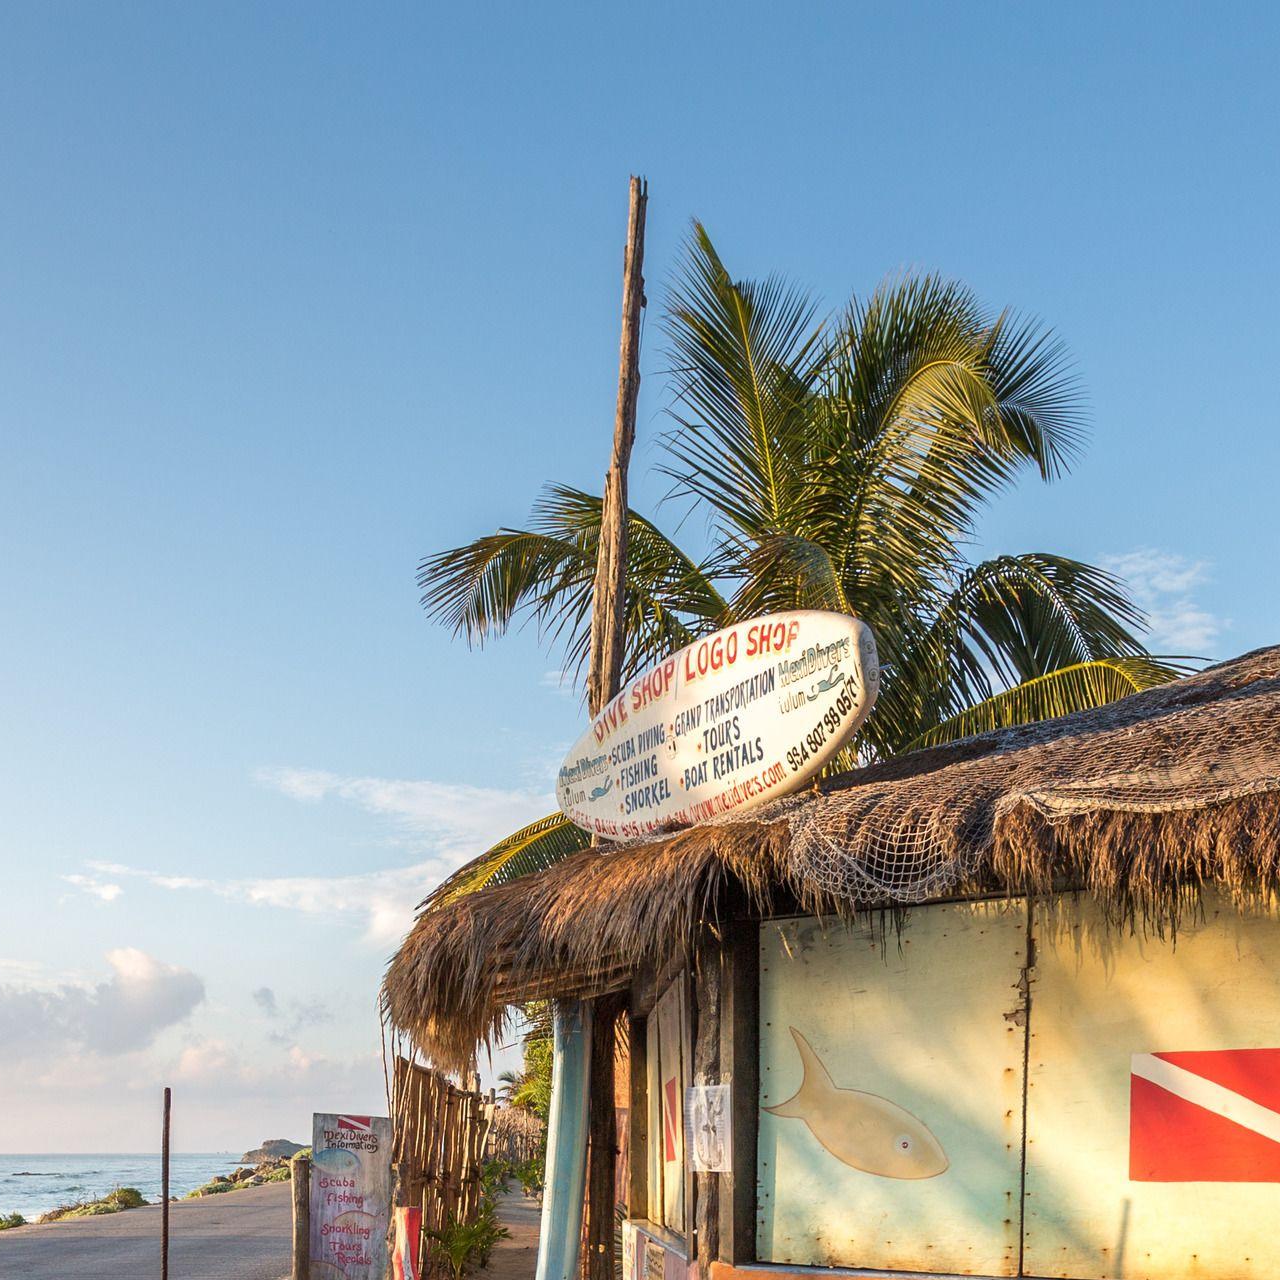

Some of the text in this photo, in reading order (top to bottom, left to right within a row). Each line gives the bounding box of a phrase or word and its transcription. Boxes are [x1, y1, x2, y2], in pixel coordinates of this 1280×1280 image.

[777, 637, 851, 688] MexiDivers
[593, 621, 799, 744] DIVE SHOP LOGO SHOP
[675, 667, 775, 737] GRAND TRANSPORTATION
[611, 723, 666, 767] SCUBA DIVING
[703, 716, 741, 754] TOURS
[806, 720, 827, 754] 807
[620, 755, 658, 791] FISHING
[684, 737, 764, 792] BOAT RENTALS
[625, 777, 671, 815] SNORKEL
[594, 817, 619, 837] DAILY
[324, 1138, 378, 1154] Information
[319, 1176, 355, 1188] Scuba
[328, 1241, 362, 1251] Tours
